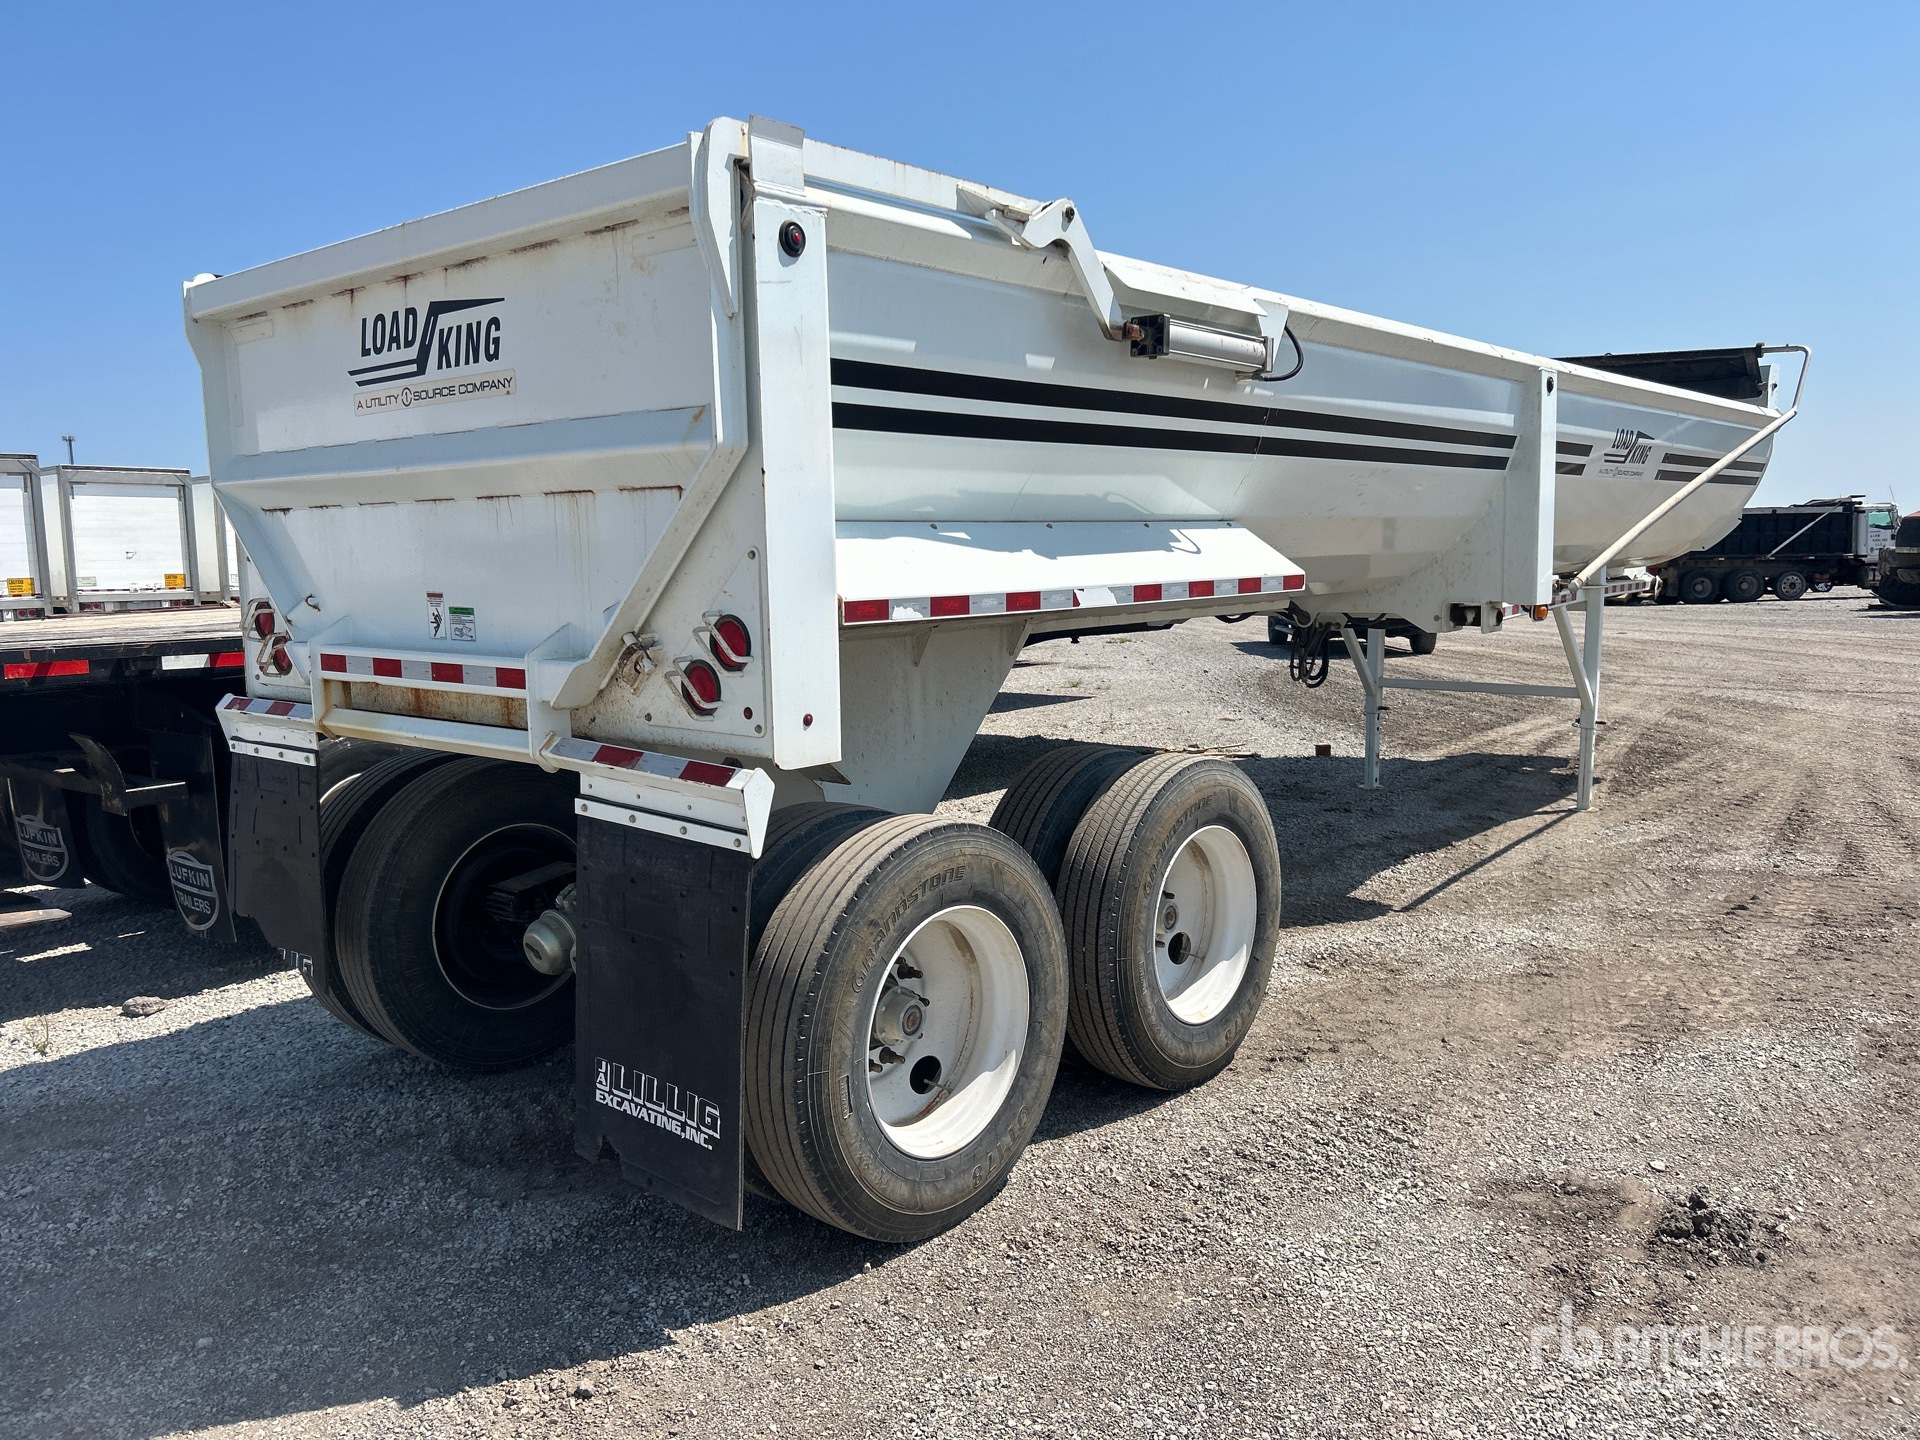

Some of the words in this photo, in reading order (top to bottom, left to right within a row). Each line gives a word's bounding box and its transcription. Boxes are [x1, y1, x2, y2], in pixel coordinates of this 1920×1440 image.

[361, 307, 418, 358] LOAD
[437, 316, 501, 370] KING
[357, 400, 364, 410] A
[366, 393, 400, 409] UTILITY
[413, 385, 456, 401] SOURCE
[458, 376, 513, 394] COMPANY
[1612, 428, 1634, 450] LOAD
[1629, 444, 1652, 464] KING
[20, 825, 58, 845] LUFKIN
[23, 848, 60, 867] TRAILERS
[170, 862, 210, 888] LUFKIN
[176, 890, 212, 915] TRAILERS
[852, 866, 966, 993] GRANDSTONE
[612, 1062, 721, 1140] LILLIG
